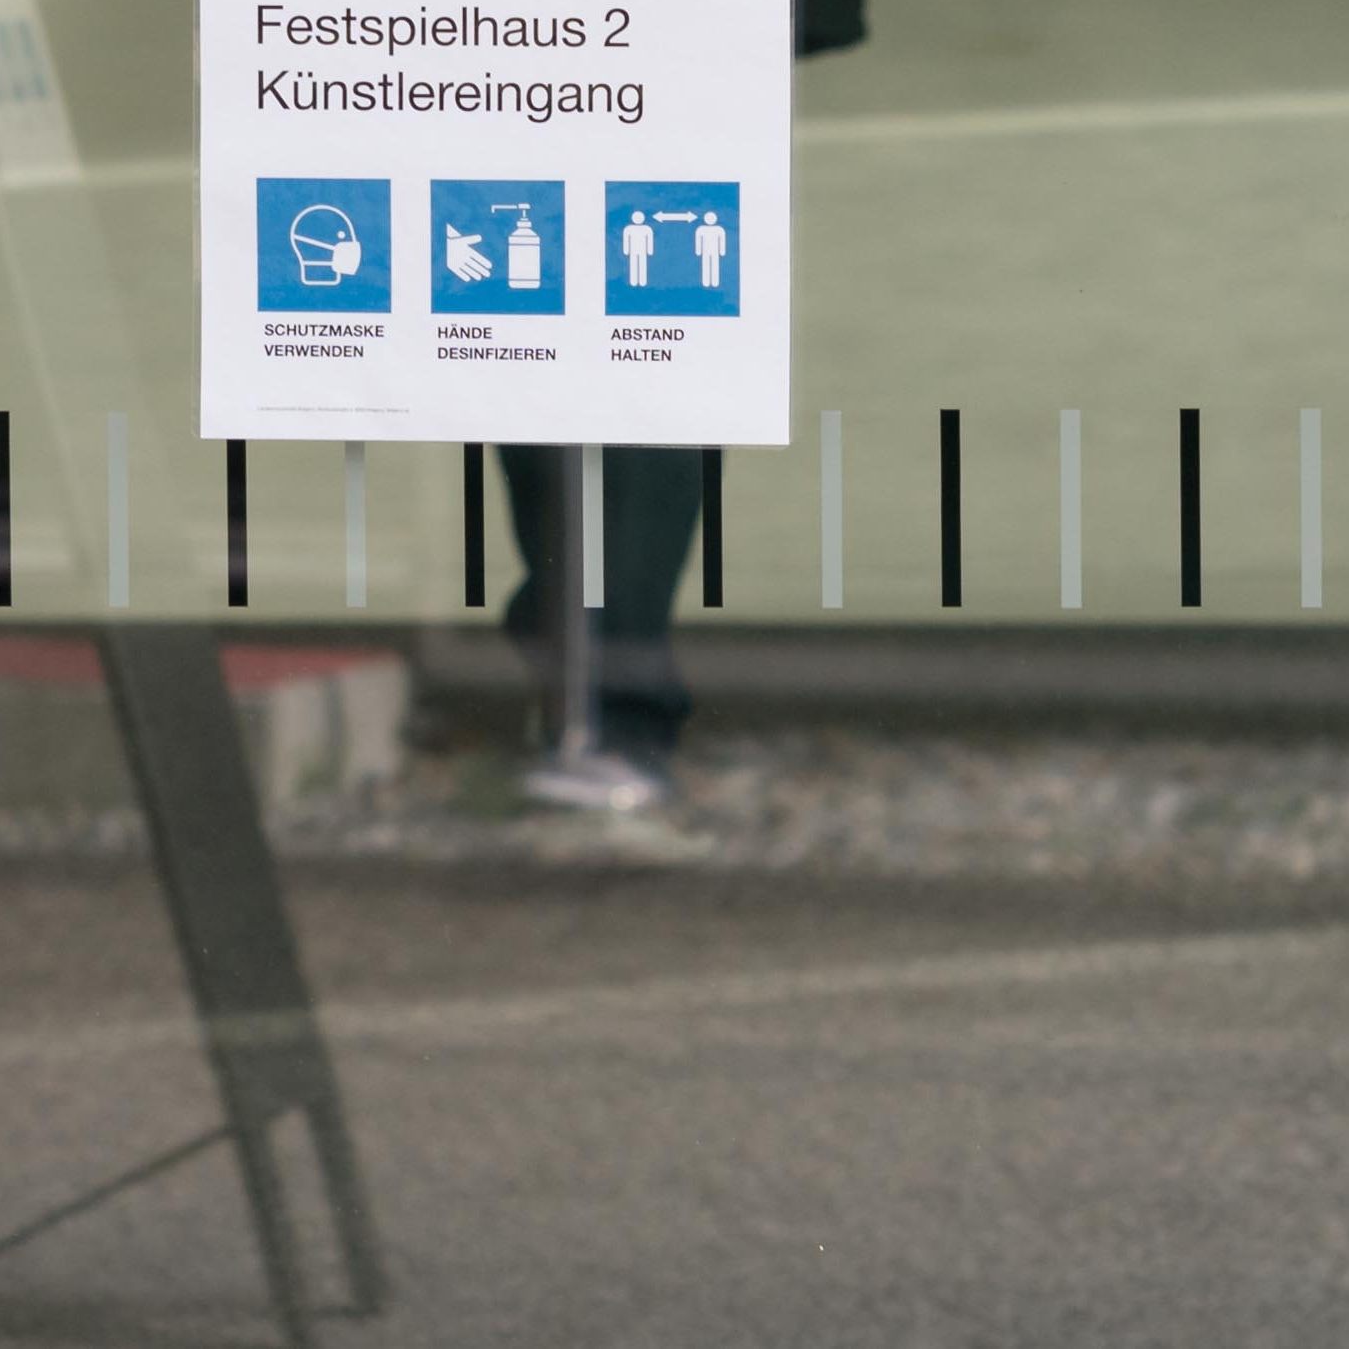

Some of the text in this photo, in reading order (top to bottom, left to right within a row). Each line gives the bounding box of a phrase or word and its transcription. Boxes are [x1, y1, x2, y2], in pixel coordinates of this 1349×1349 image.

[256, 5, 631, 55] Festspielhaus 2
[256, 70, 645, 124] Künstlereingang
[264, 323, 385, 338] SCHUTZMASKE
[437, 323, 493, 340] HÄNDE
[610, 327, 685, 342] ABSTAND
[264, 344, 365, 358] VERWENDEN
[437, 347, 557, 361] DESINFIZIEREN
[610, 348, 672, 362] HALTEN
